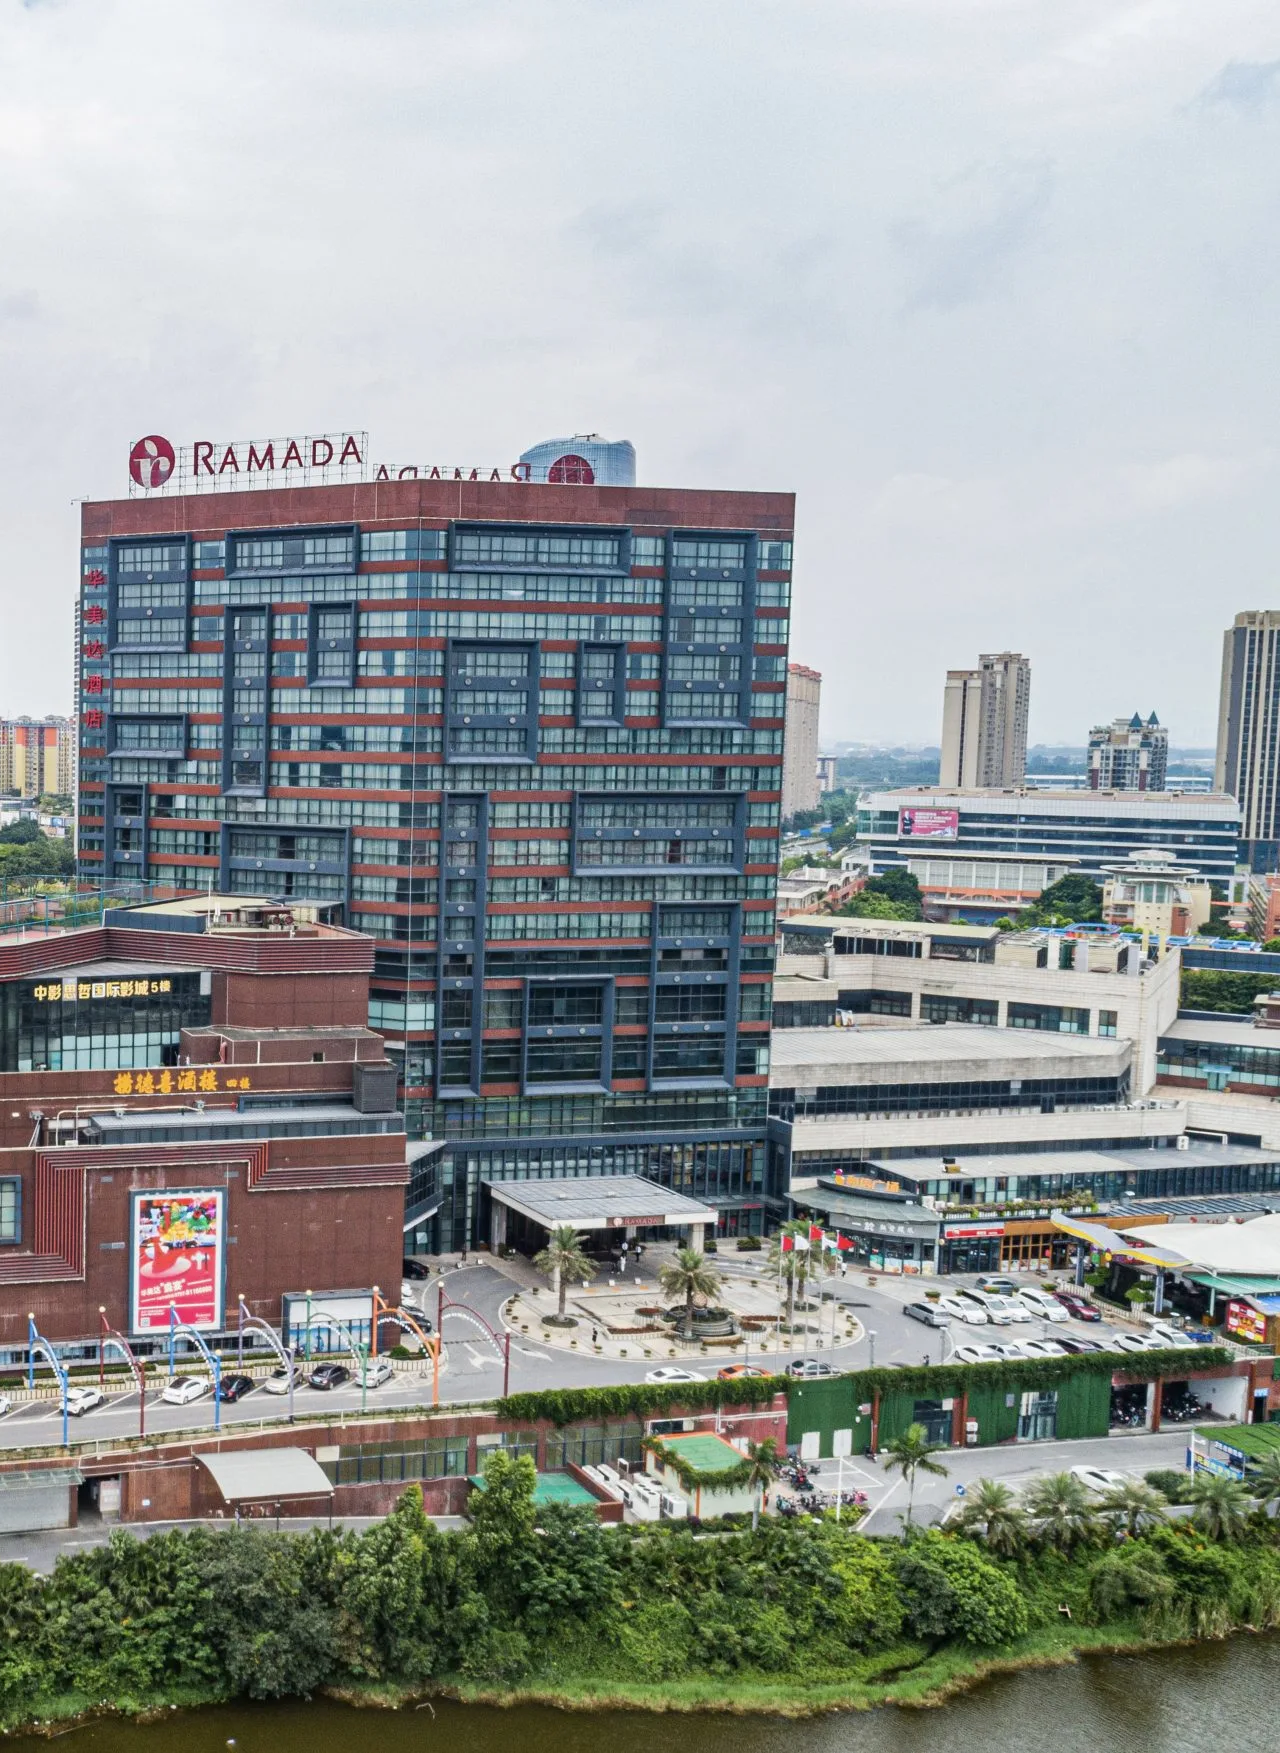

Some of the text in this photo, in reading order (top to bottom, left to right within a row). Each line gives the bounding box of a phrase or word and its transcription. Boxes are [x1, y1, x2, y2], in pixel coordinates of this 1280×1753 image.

[193, 435, 362, 475] RAMADA
[86, 569, 105, 729] 华美达酒店
